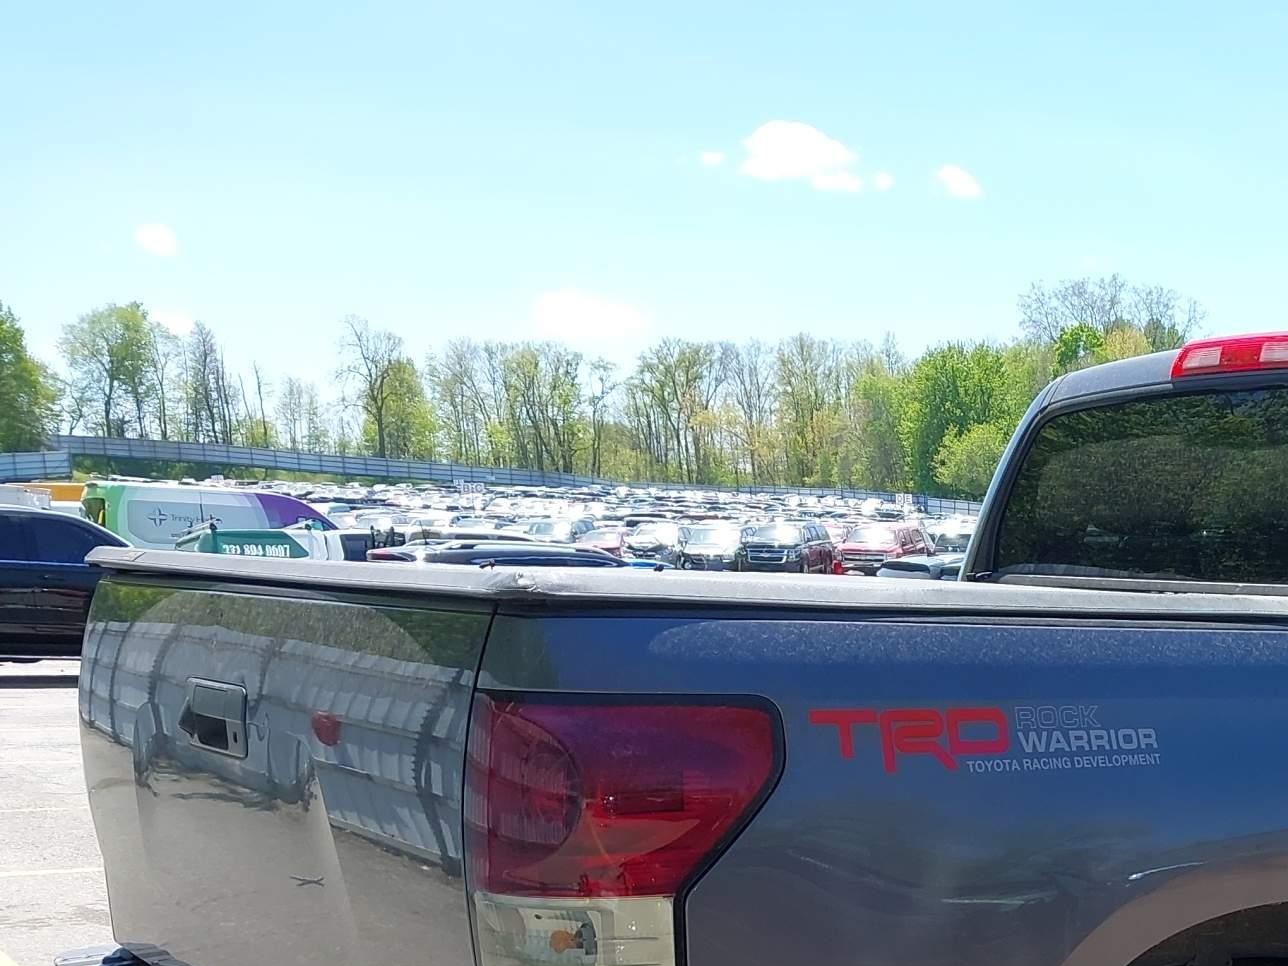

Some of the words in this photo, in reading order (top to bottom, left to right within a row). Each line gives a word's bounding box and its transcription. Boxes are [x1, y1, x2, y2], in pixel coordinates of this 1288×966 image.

[1015, 705, 1101, 729] ROCK
[809, 707, 1008, 775] TRD
[1017, 728, 1158, 753] WARRIOR
[966, 758, 1020, 773] TOYOTA
[1023, 756, 1071, 771] RACING
[1074, 753, 1160, 769] DEVELOPMENT
